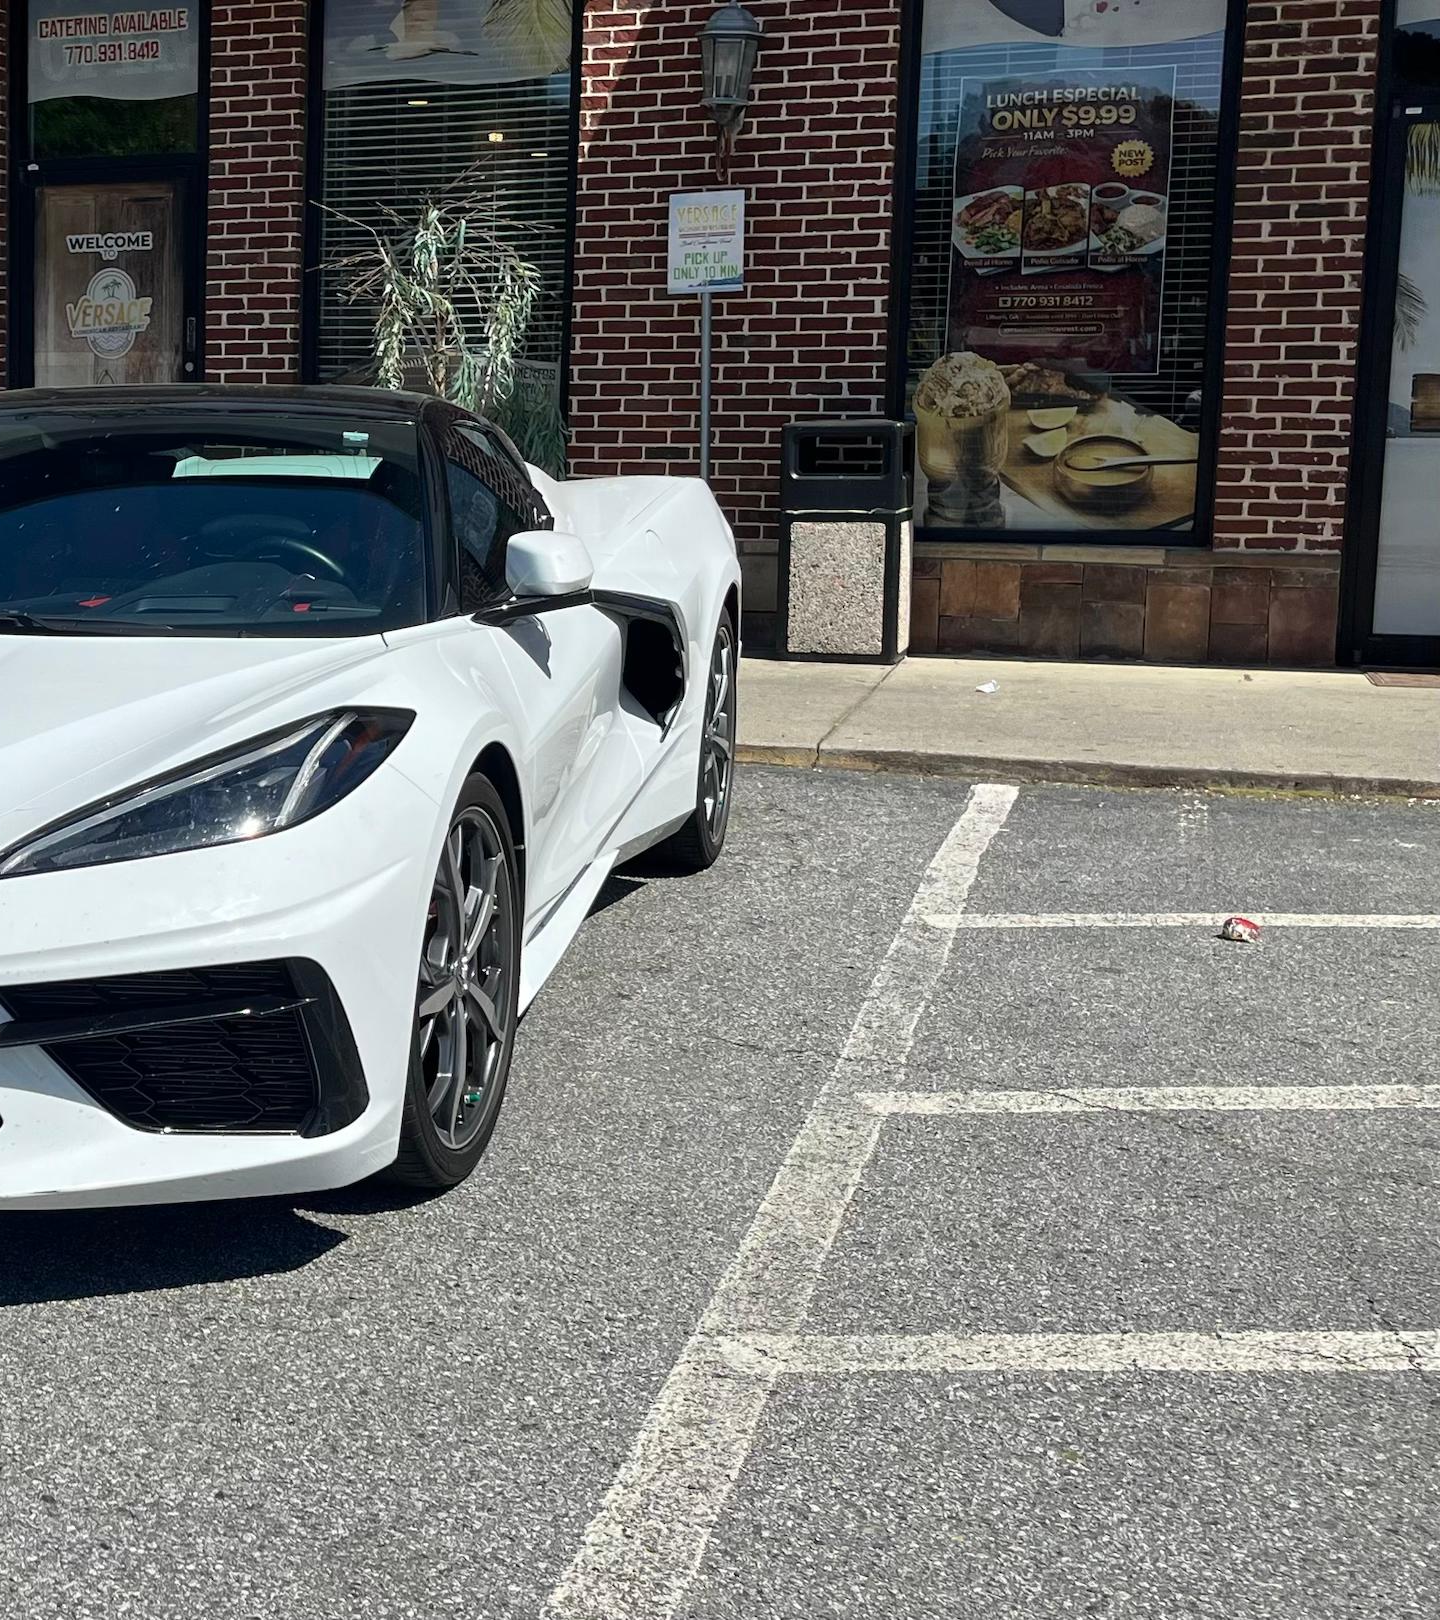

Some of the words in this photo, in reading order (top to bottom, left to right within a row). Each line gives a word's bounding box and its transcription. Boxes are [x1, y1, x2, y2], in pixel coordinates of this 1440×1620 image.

[38, 16, 108, 39] CATERING
[112, 10, 187, 34] AVAILABLE
[64, 40, 159, 65] 770.931.8412
[986, 90, 1048, 109] LUNCH
[1052, 86, 1142, 104] ESPECIAL
[991, 107, 1058, 131] ONLY
[1061, 104, 1137, 128] $9.99
[1023, 130, 1055, 141] 11AM
[1066, 129, 1095, 139] 3PM
[1118, 149, 1146, 158] NEW
[1117, 157, 1145, 167] POST
[676, 204, 738, 224] VERSACE
[68, 234, 151, 250] WELCOME
[103, 249, 117, 258] TO
[684, 251, 709, 265] PICK
[713, 250, 728, 264] UP
[673, 267, 700, 280] ONLY
[704, 265, 716, 279] 10
[720, 264, 738, 278] MIN
[1013, 297, 1037, 307] 770
[1039, 297, 1060, 306] 931
[1064, 296, 1093, 306] 8412
[67, 298, 151, 329] VERSACE
